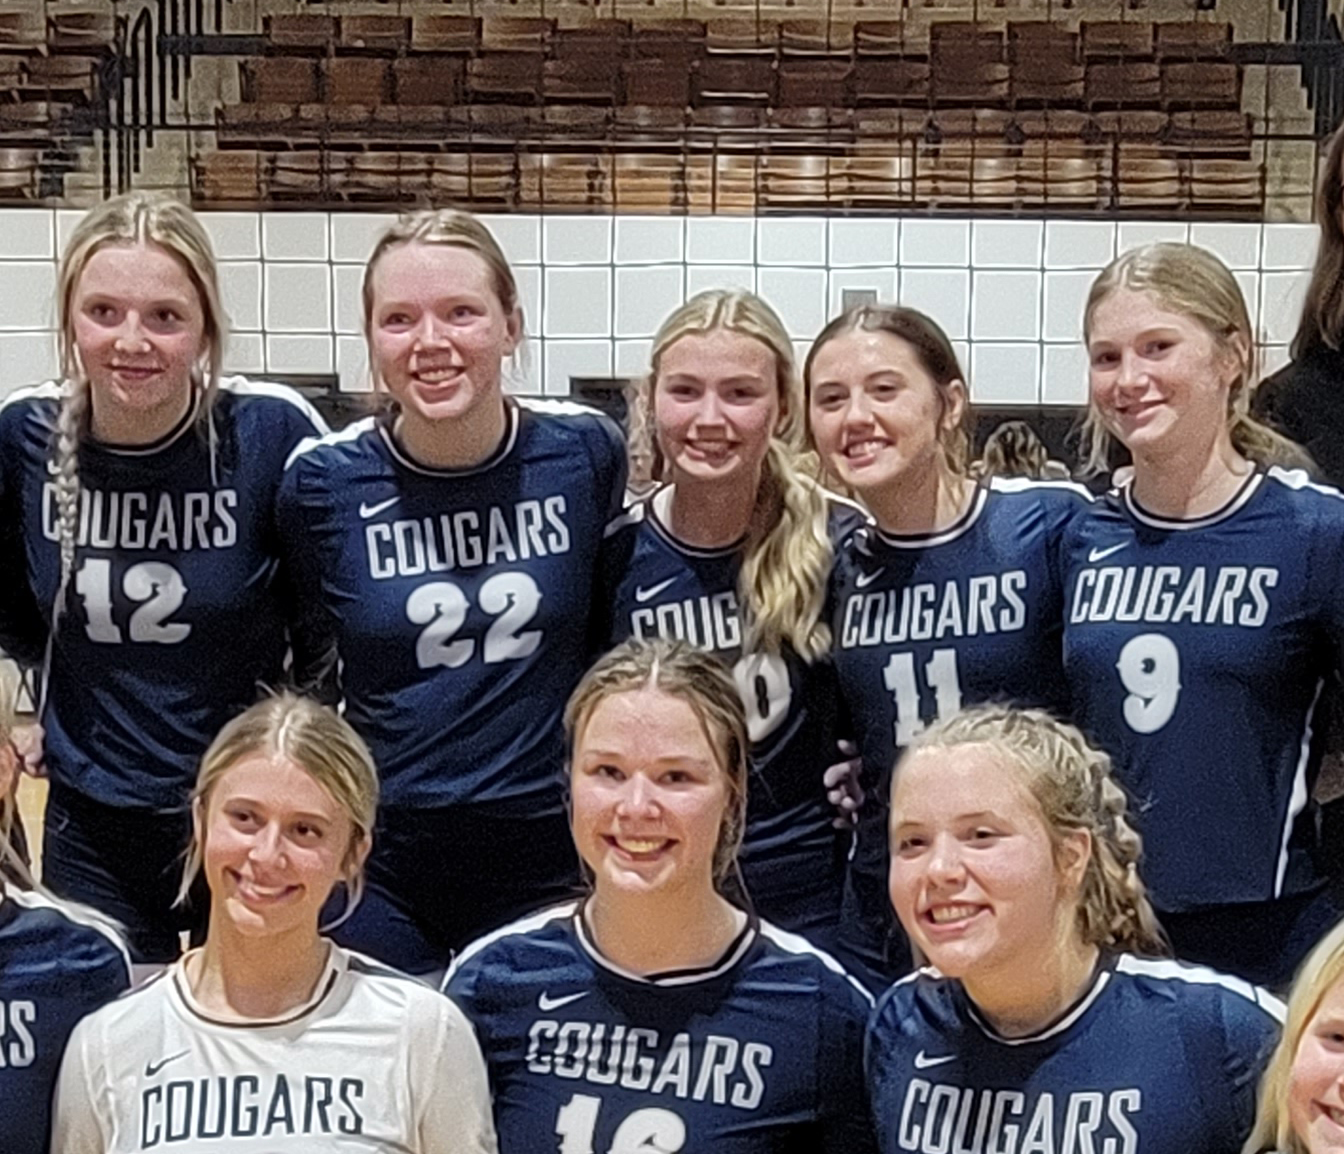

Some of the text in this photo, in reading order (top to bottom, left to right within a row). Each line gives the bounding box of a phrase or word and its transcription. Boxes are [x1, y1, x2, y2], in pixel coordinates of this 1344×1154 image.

[365, 495, 570, 580] COUGARS
[76, 557, 192, 643] 12
[406, 572, 543, 669] 22
[631, 591, 742, 652] COUG
[841, 570, 1027, 648] COUGARS
[1070, 566, 1279, 626] COUGARS
[733, 653, 792, 742] 0
[883, 648, 963, 748] 11
[1117, 633, 1182, 734] 9
[526, 1020, 773, 1108] COUGARS
[141, 1073, 364, 1150] COUGARS
